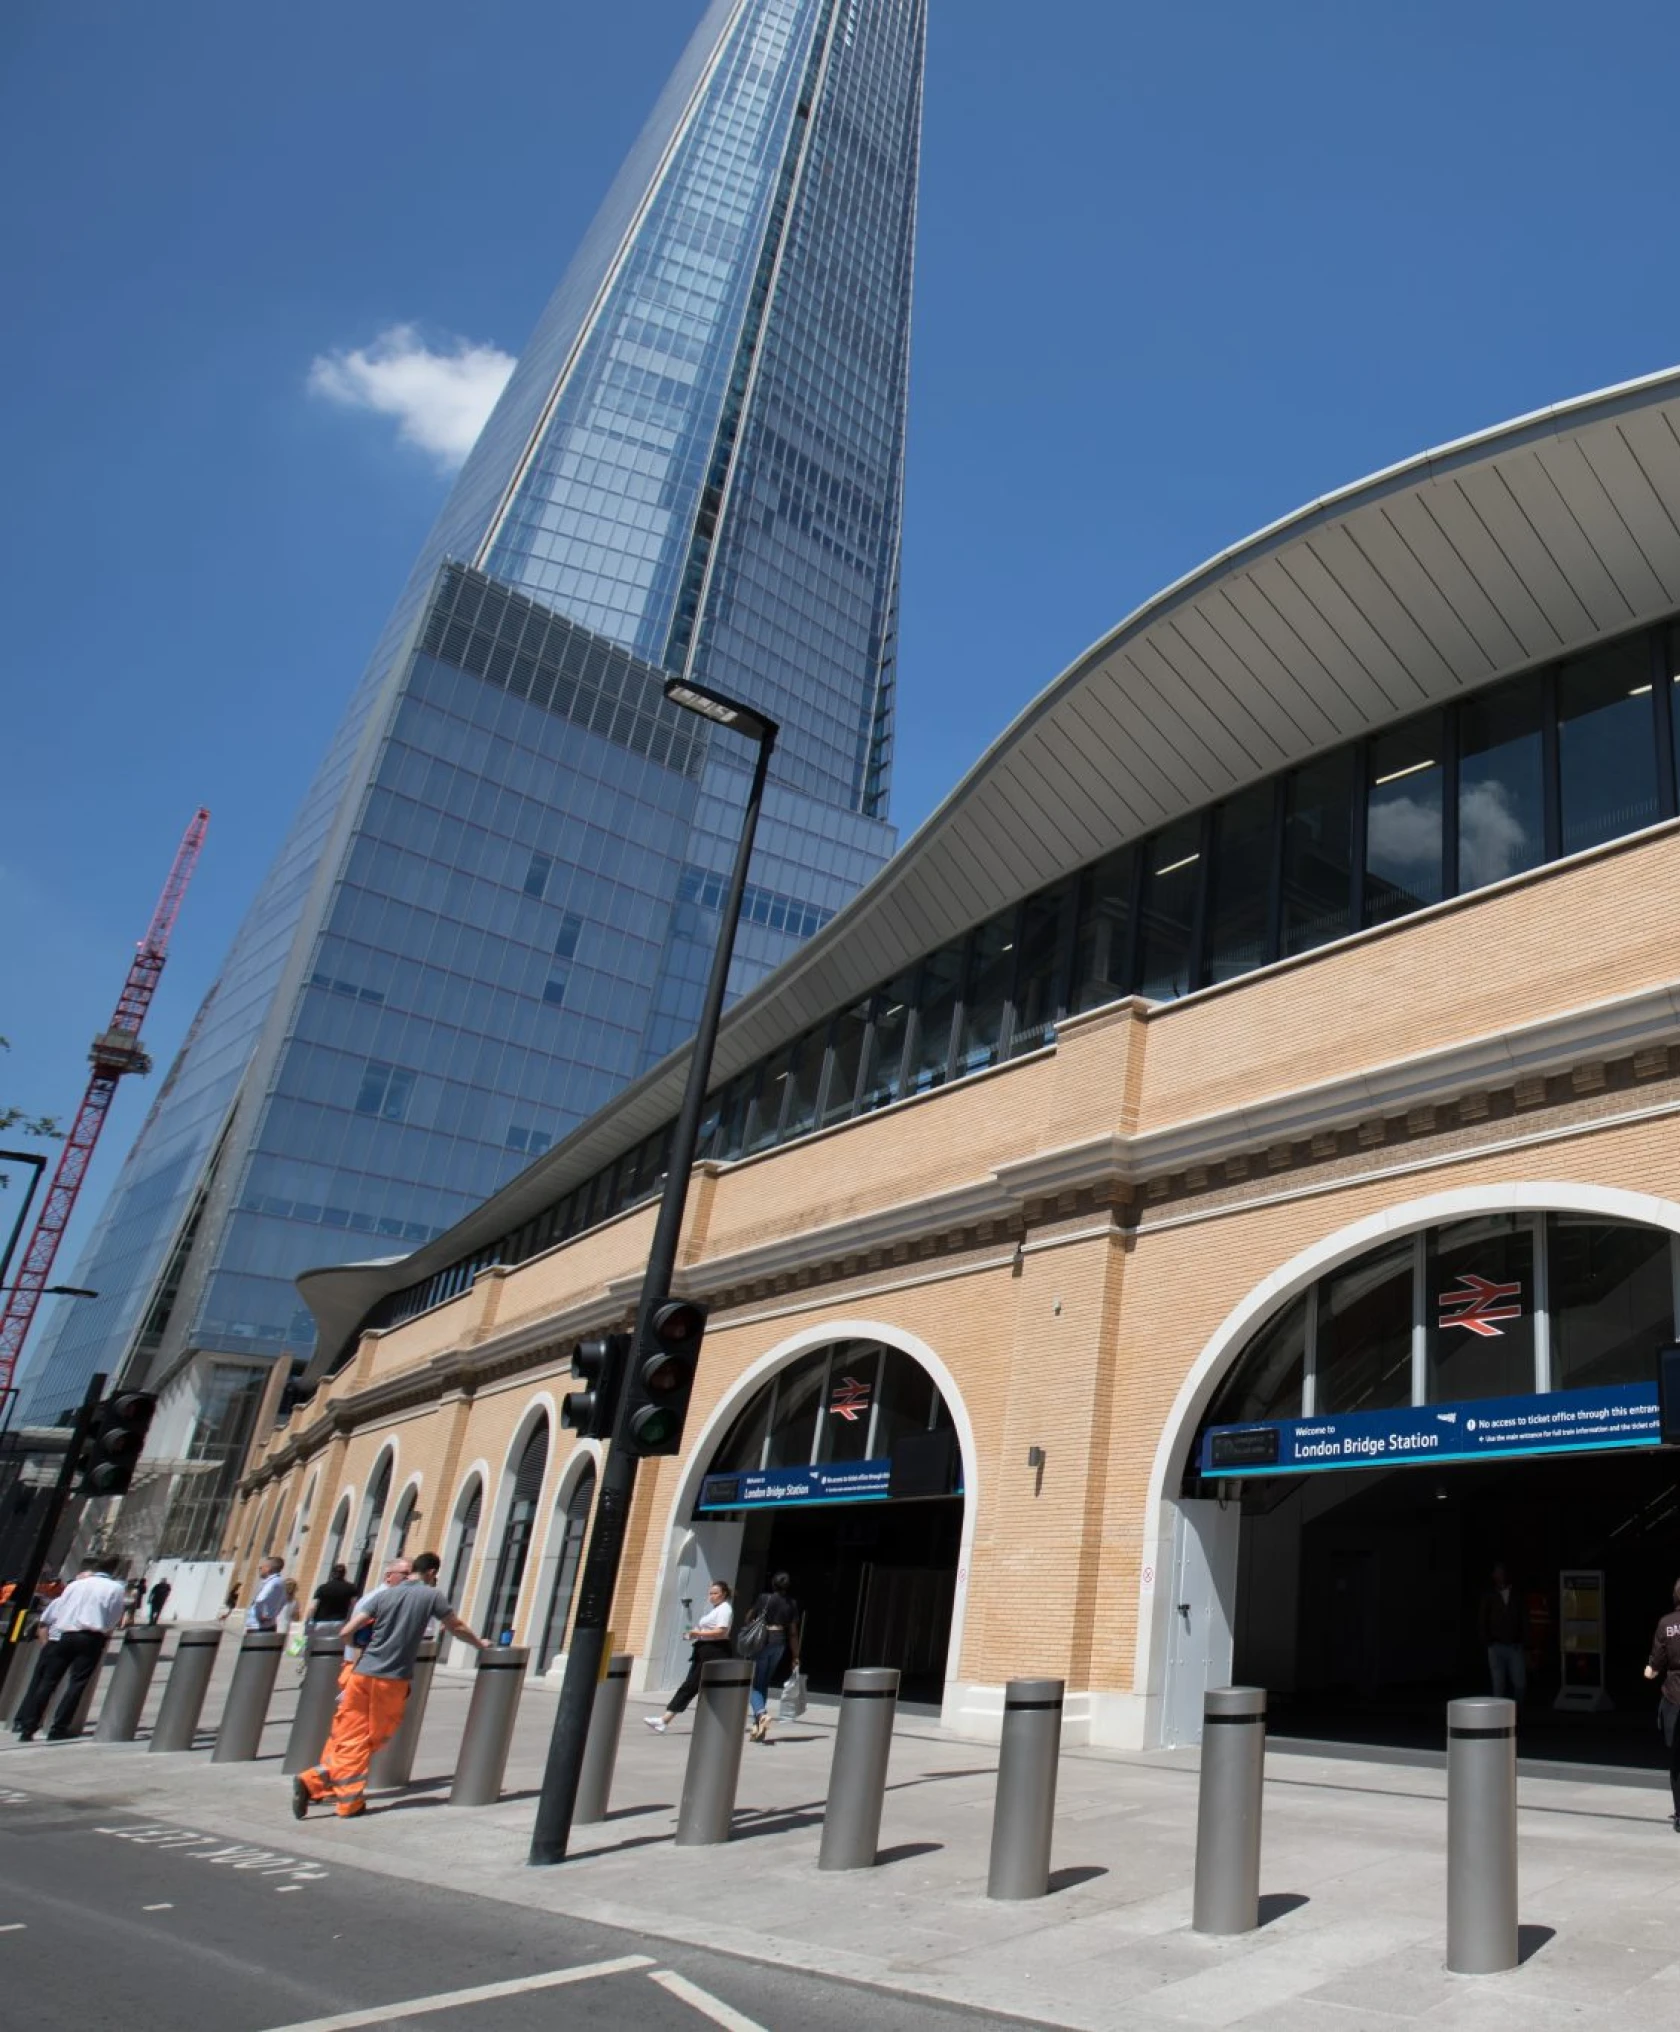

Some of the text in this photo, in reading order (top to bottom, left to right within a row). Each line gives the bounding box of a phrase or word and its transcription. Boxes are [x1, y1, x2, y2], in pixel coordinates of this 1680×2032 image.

[1478, 1420, 1490, 1428] No
[1491, 1418, 1516, 1428] access
[1518, 1416, 1526, 1426] to
[1528, 1414, 1550, 1424] ticket
[1552, 1411, 1576, 1422] office
[1577, 1407, 1610, 1420] through
[1612, 1406, 1627, 1416] this
[1295, 1424, 1336, 1437] Welcome to
[1294, 1430, 1438, 1459] London Bridge Station
[1667, 1623, 1680, 1636] BA
